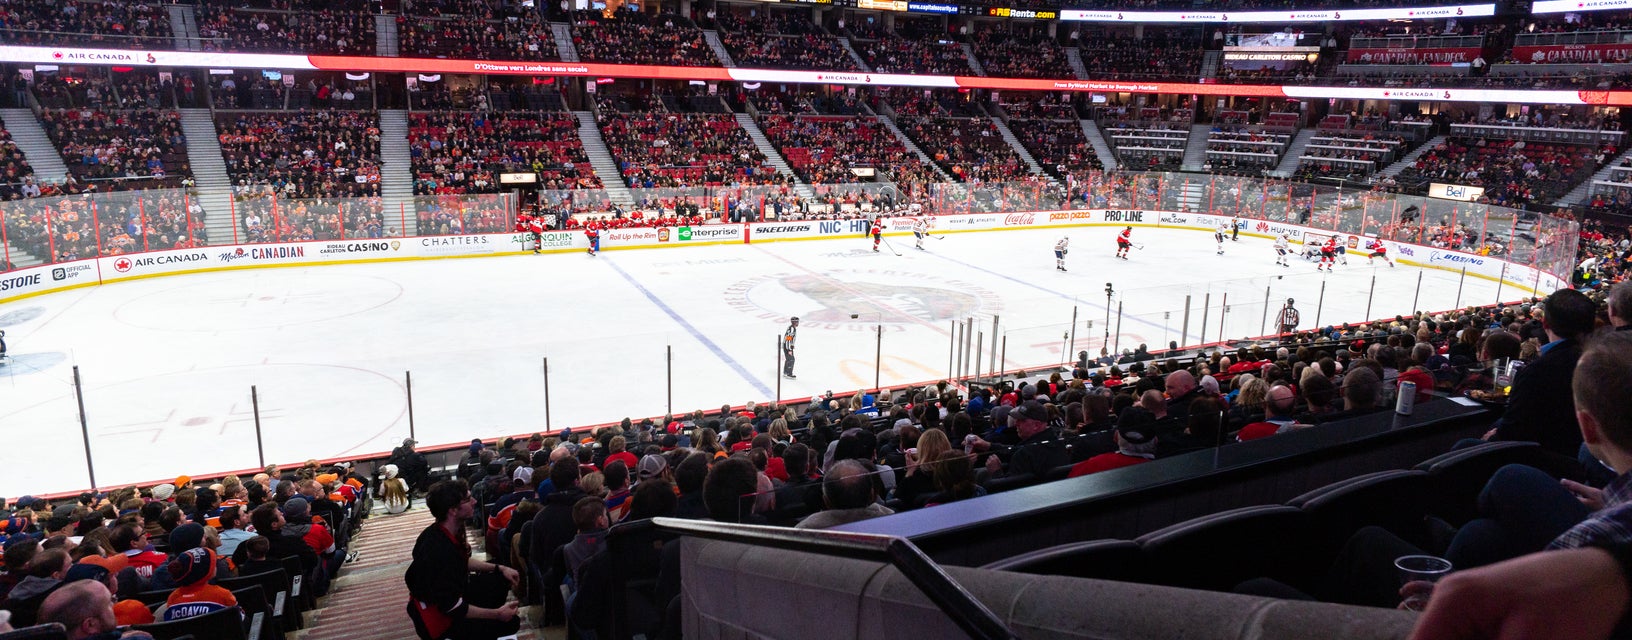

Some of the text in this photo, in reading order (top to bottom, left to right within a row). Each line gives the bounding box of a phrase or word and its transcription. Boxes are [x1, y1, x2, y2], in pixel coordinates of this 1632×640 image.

[909, 4, 957, 12] www.capitalsecurity.ca
[1374, 53, 1418, 62] CANADIAN
[1444, 52, 1466, 62] DECK
[1548, 49, 1628, 61] CANADIAN FAN
[1446, 186, 1465, 198] Bell
[1050, 212, 1090, 222] pizza pizza
[1197, 217, 1213, 225] Fibe
[681, 228, 738, 238] enterprise
[755, 225, 811, 234] SKECHERS
[422, 236, 487, 246] CHATTERS
[347, 242, 388, 252] CASINO
[218, 246, 304, 262] Molson CANADIAN
[135, 253, 207, 267] AIR CANADA
[1443, 254, 1484, 266] BOEING
